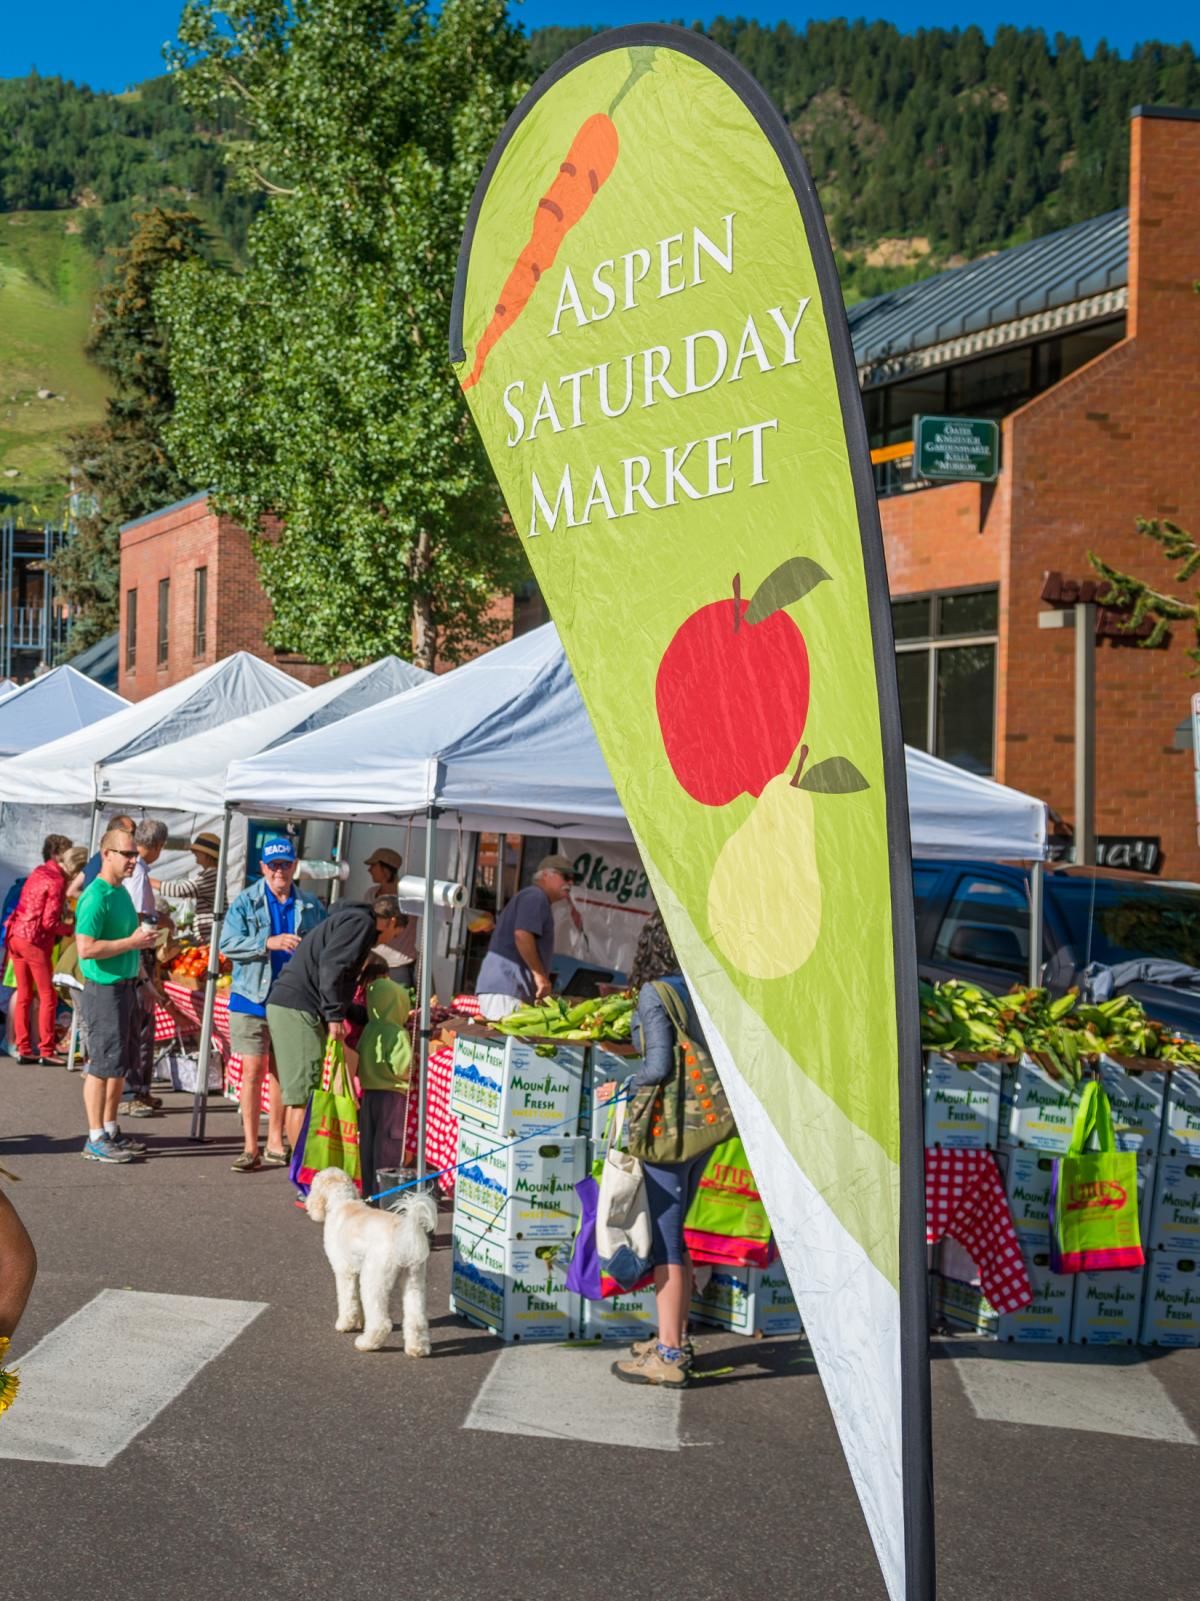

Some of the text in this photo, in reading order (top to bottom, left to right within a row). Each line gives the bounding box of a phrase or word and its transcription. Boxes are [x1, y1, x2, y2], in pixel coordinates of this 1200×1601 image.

[547, 211, 737, 338] ASPEN
[501, 296, 813, 449] SATURDAY
[526, 418, 780, 539] MARKET
[510, 1073, 570, 1096] MOUNTAIN
[524, 1093, 555, 1110] FRESH
[947, 1105, 977, 1122] FRESH
[1038, 1106, 1067, 1124] FRESH
[515, 1173, 574, 1196] MOUNTAIN
[530, 1195, 561, 1210] FRESH
[527, 1295, 558, 1311] FRESH
[612, 1296, 643, 1311] FRESH
[1097, 1302, 1124, 1317] FRESH
[1166, 1304, 1193, 1320] FRESH
